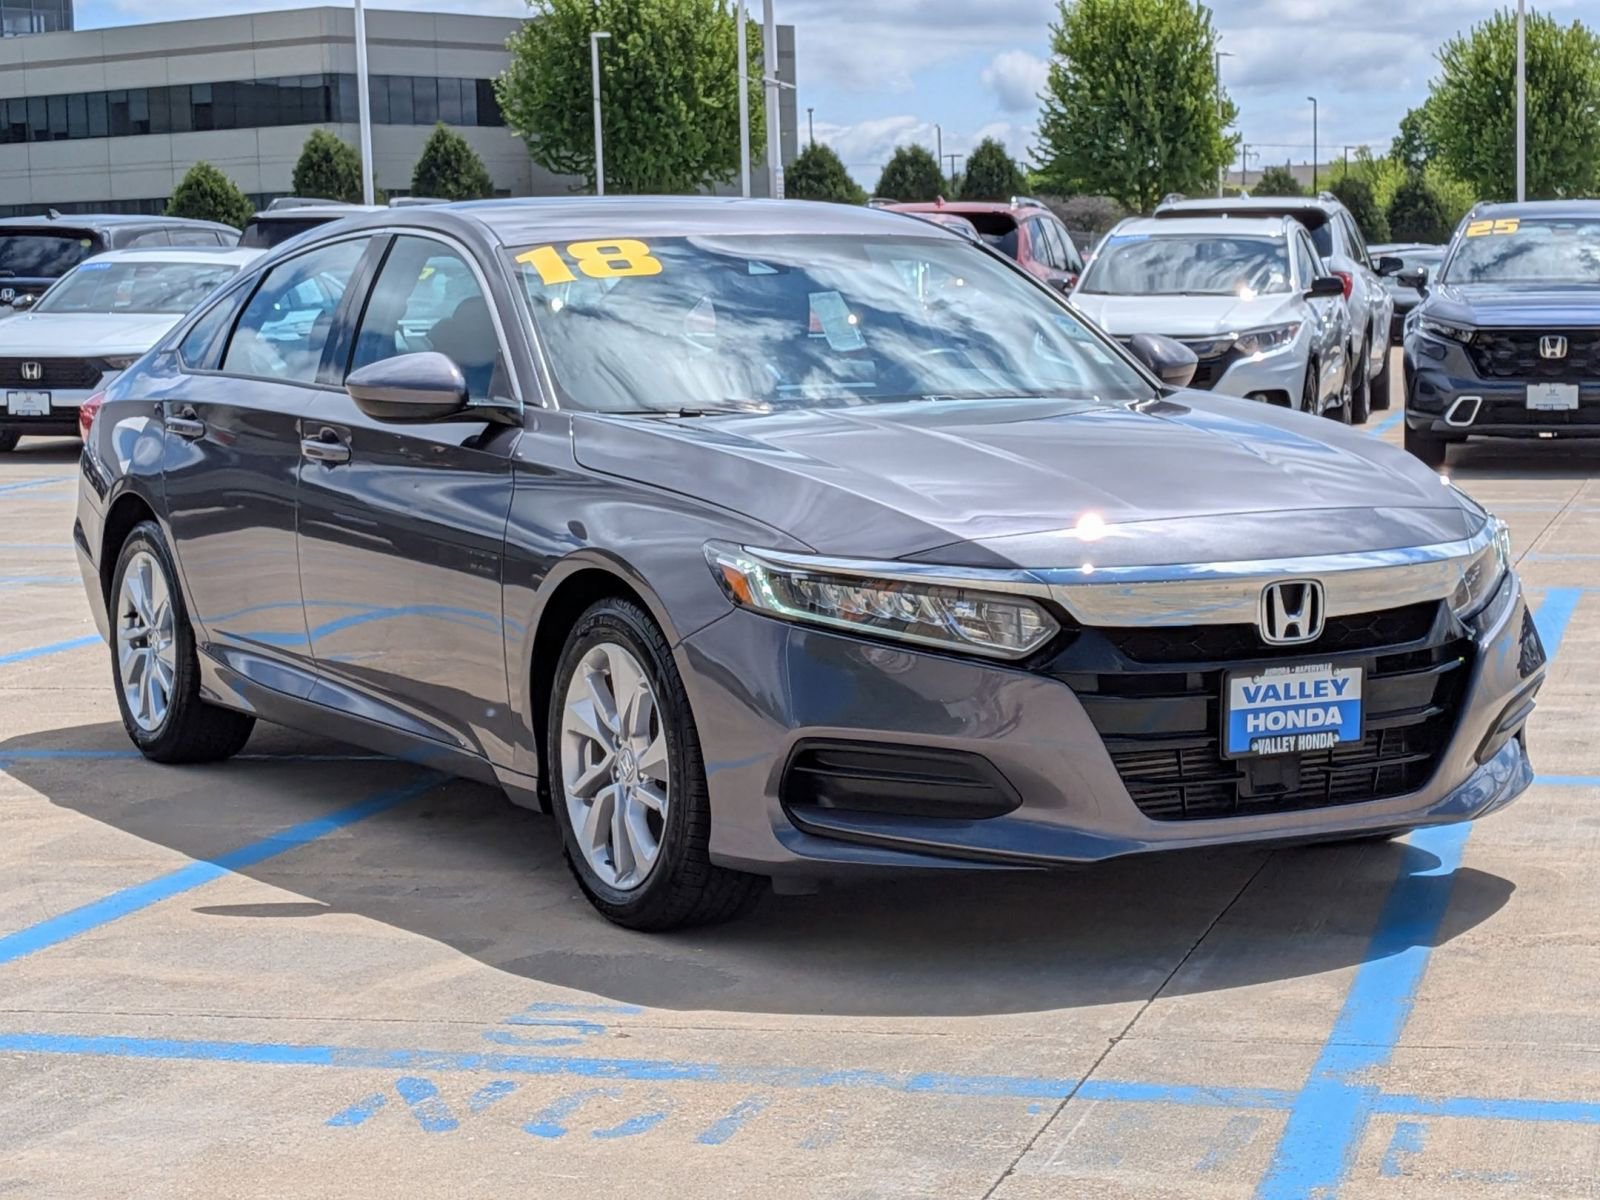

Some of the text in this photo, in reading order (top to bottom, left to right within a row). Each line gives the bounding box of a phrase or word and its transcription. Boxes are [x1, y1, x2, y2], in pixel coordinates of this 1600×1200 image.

[1466, 218, 1520, 237] 25
[515, 239, 663, 285] 18
[1243, 678, 1349, 704] VALLEY
[1247, 706, 1343, 733] HONDA
[1258, 732, 1334, 755] VALLEY HONDA
